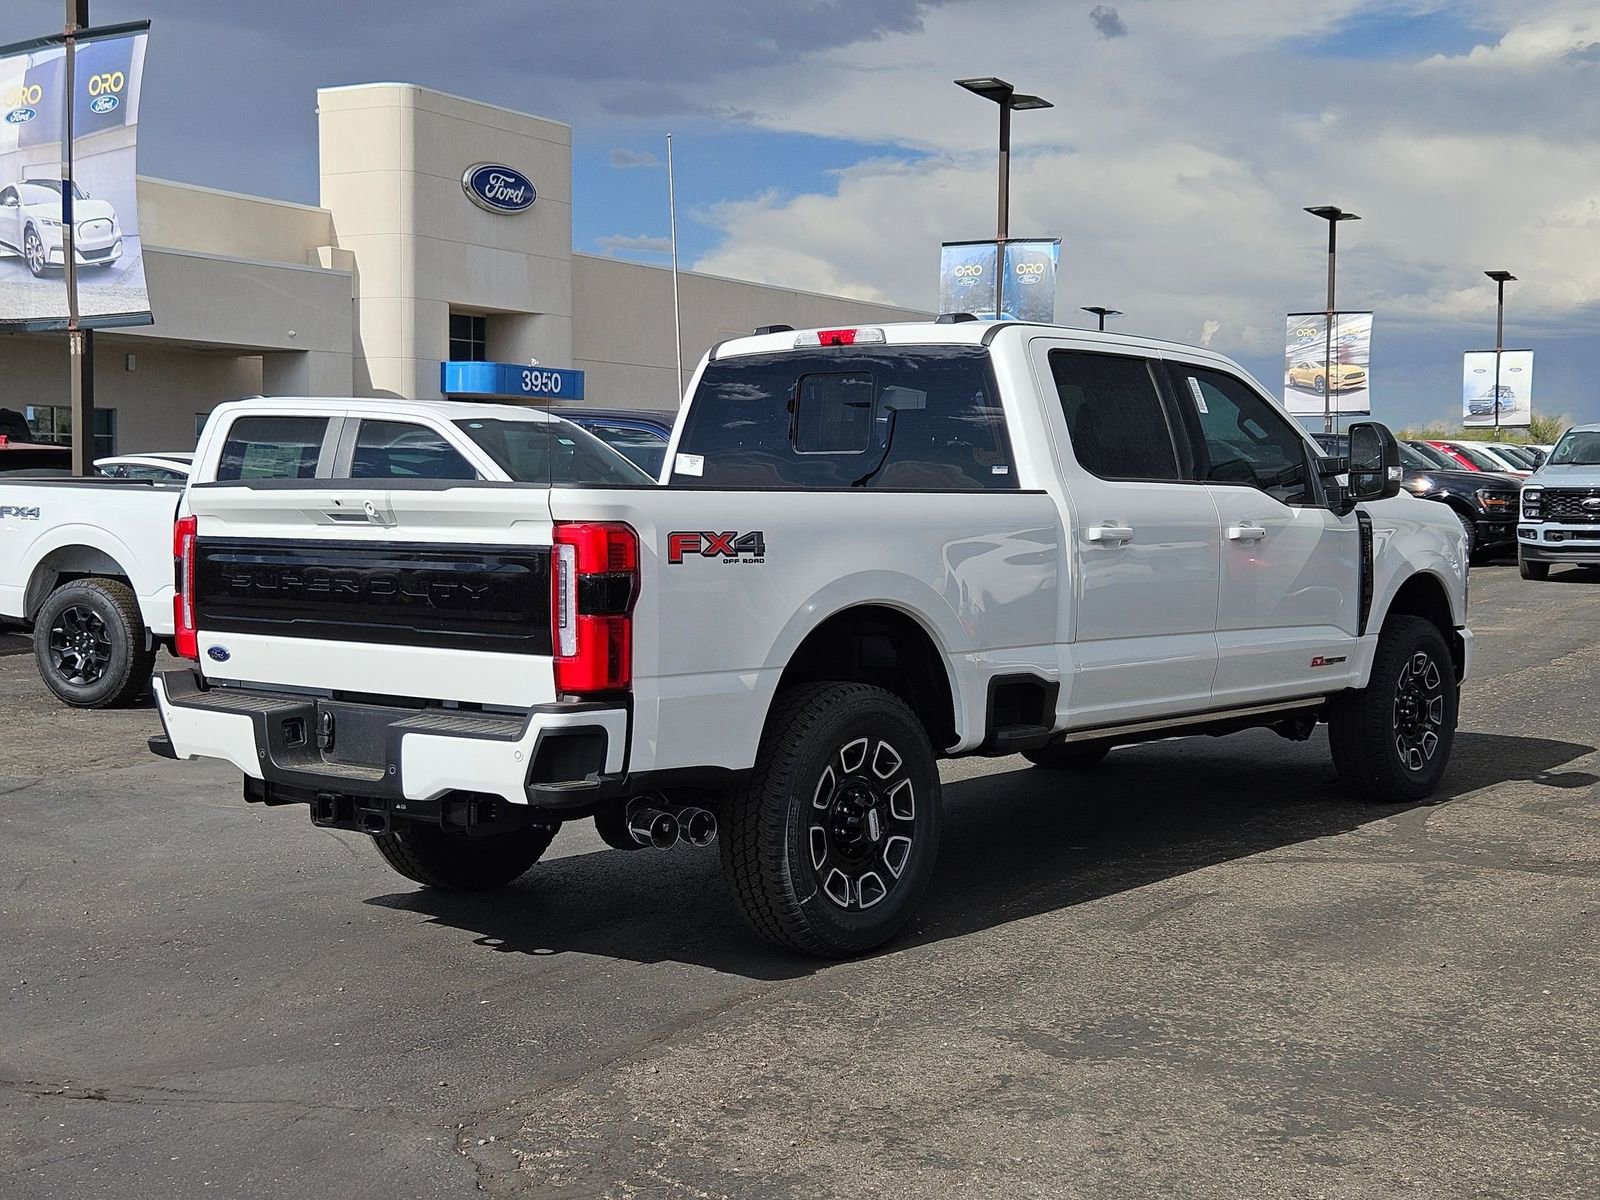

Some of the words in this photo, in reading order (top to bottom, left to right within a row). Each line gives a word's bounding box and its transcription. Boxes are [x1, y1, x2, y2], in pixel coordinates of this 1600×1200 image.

[88, 71, 125, 96] ORO
[4, 84, 43, 107] ORO
[485, 173, 525, 204] Ford
[954, 265, 983, 277] ORO
[1016, 263, 1044, 274] ORO
[1296, 328, 1317, 337] ORO
[521, 370, 561, 393] 3950
[0, 506, 40, 518] FX4
[667, 531, 765, 564] FX4
[229, 573, 361, 594] SUPER
[369, 578, 490, 600] DUTY
